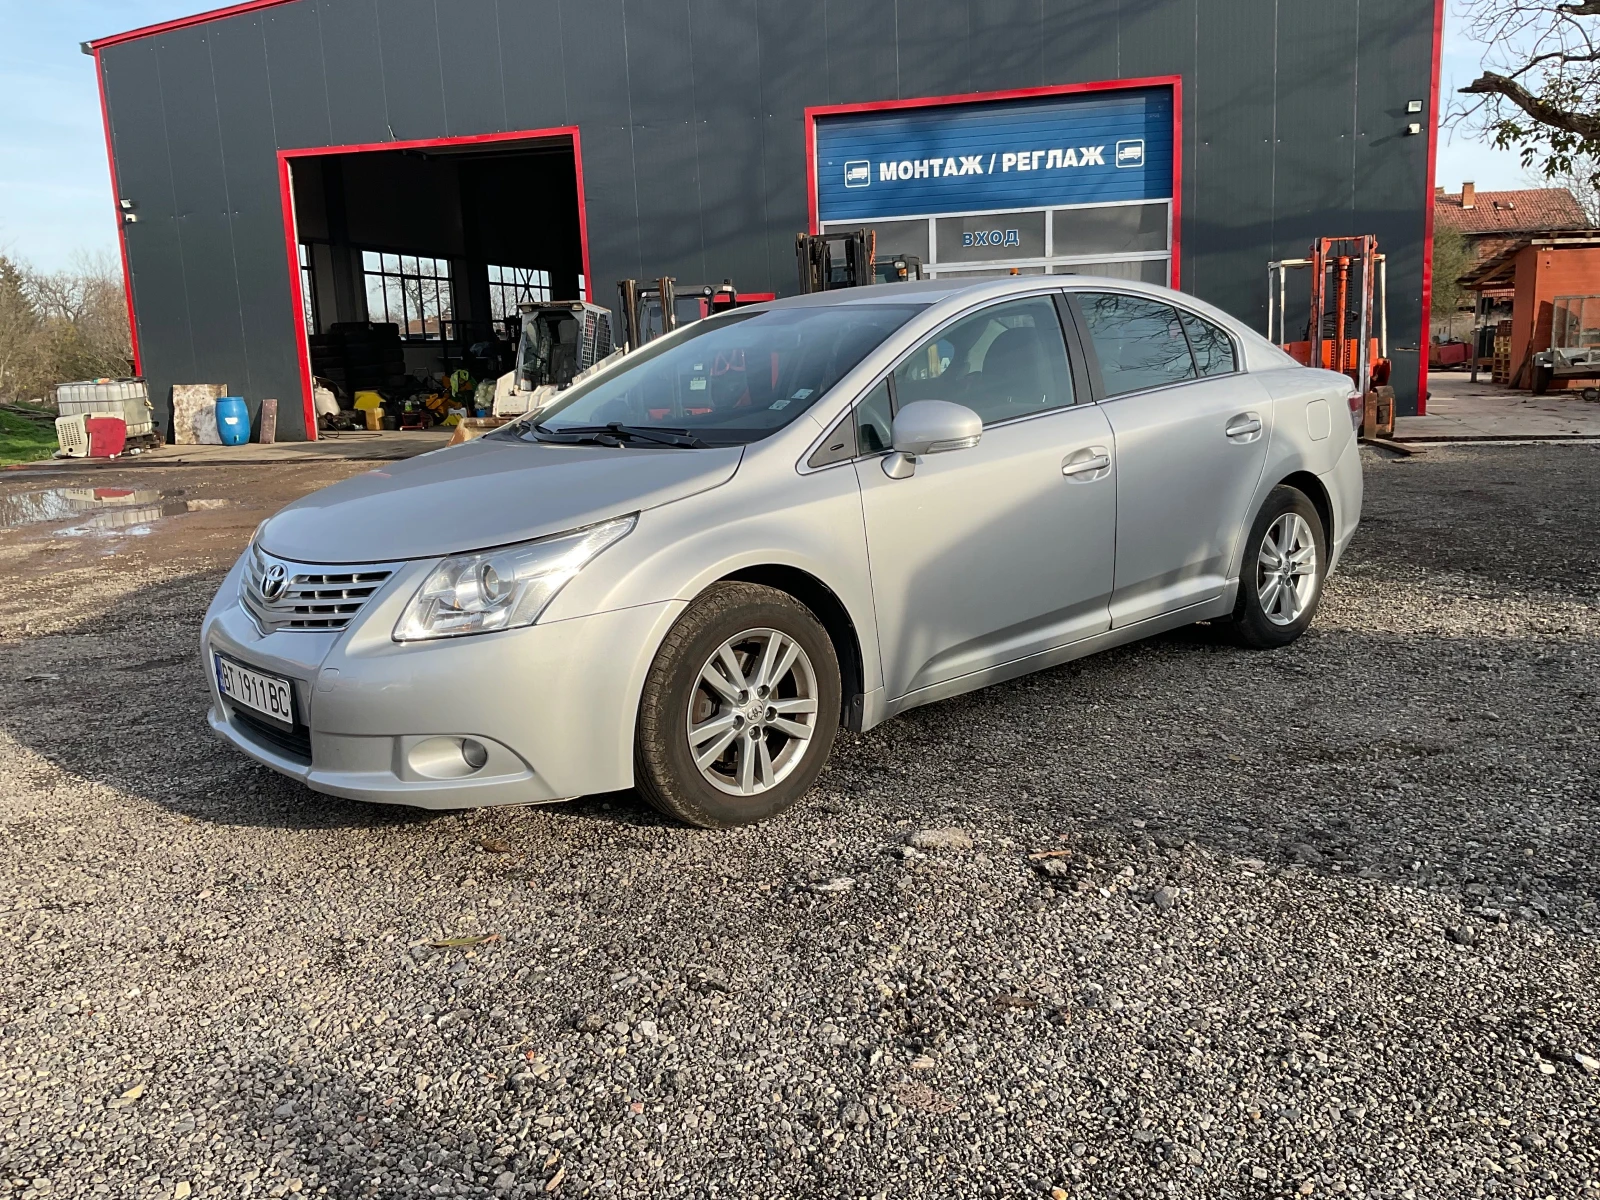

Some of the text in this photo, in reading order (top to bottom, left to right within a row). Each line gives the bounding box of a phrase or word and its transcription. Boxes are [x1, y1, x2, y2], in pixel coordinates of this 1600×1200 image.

[879, 153, 984, 182] МОНТАЖ
[1002, 145, 1105, 173] РЕГЛАЖ
[962, 229, 1020, 248] ВХОД
